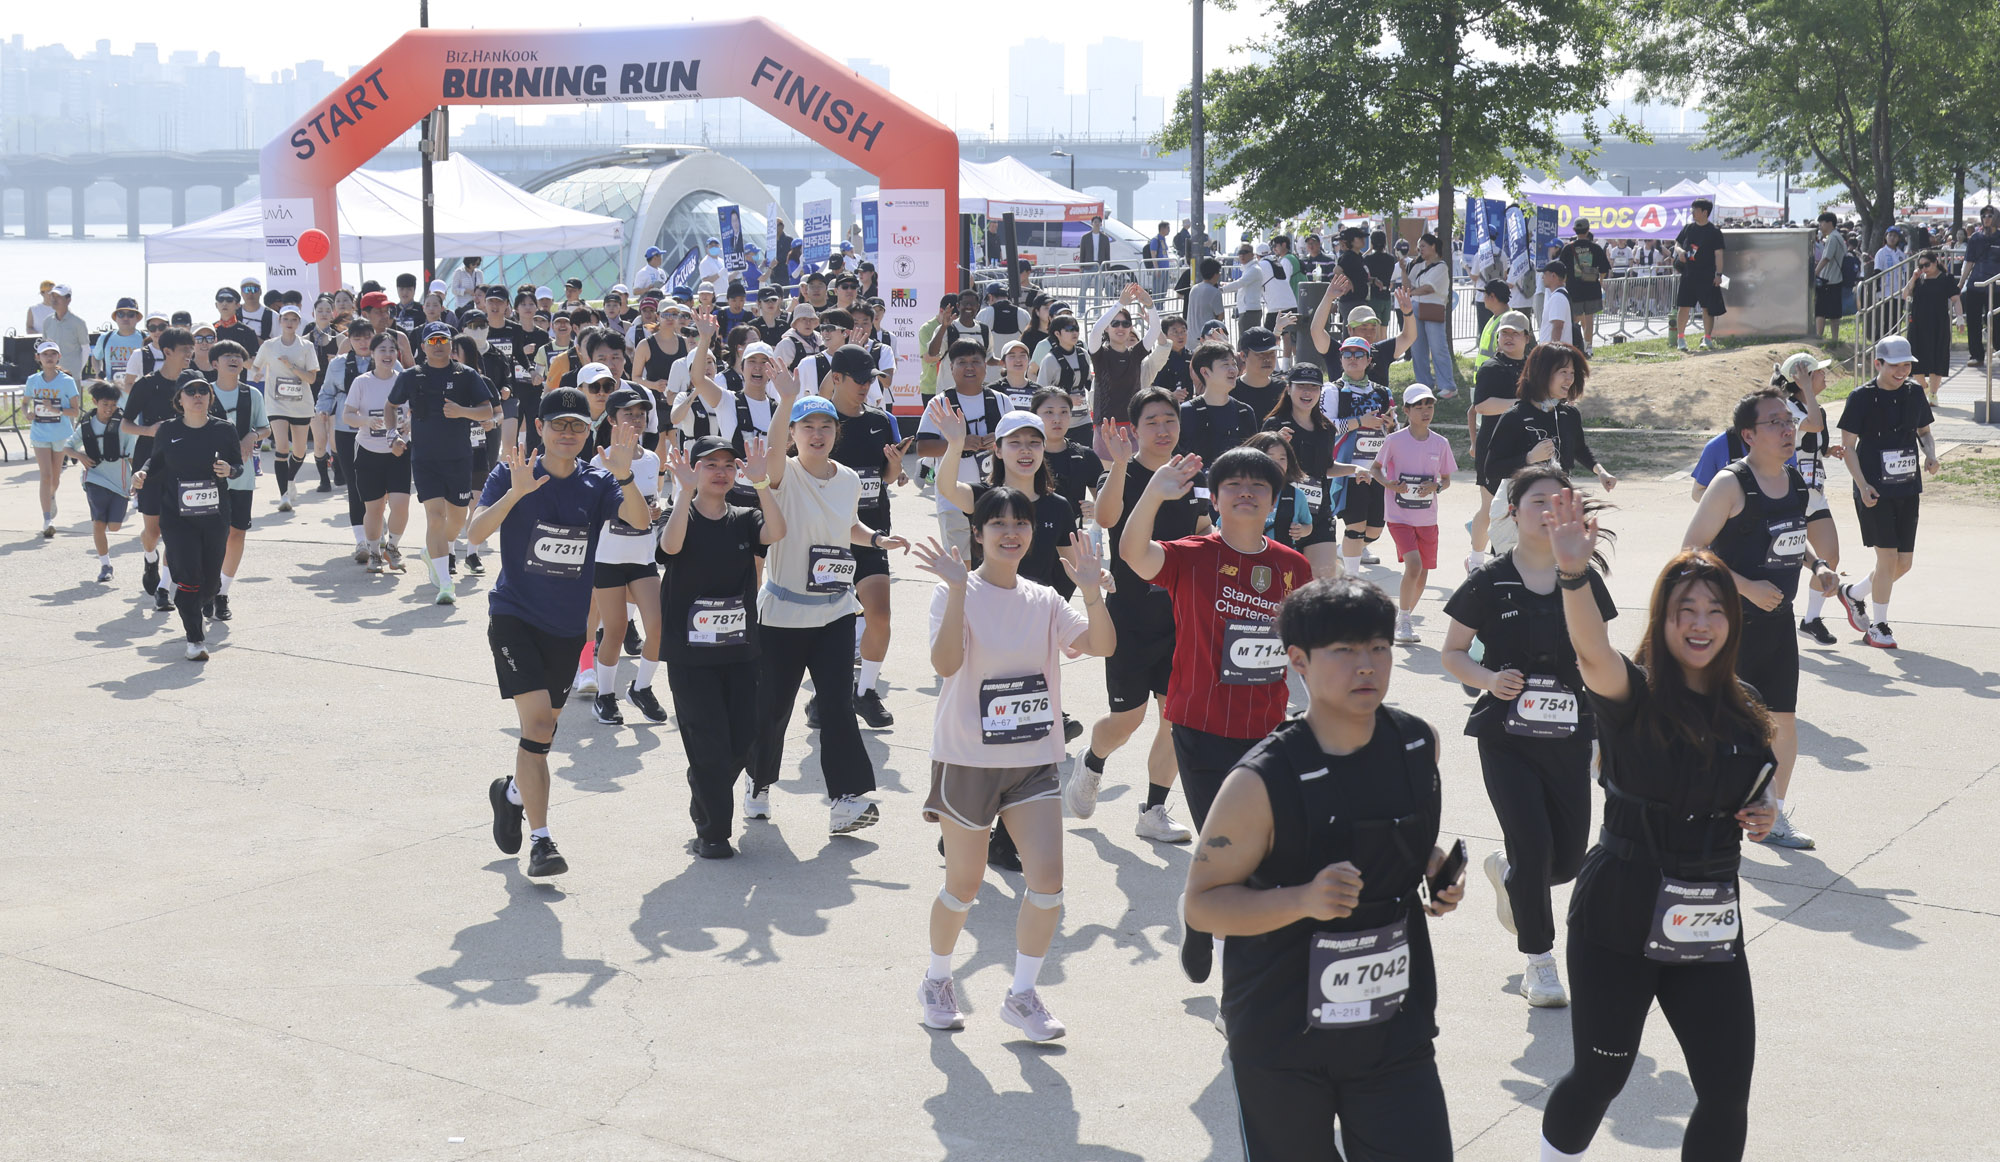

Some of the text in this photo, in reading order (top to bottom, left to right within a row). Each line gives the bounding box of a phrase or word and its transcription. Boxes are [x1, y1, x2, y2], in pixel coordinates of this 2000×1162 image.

[443, 59, 701, 98] BURNING RUN
[612, 94, 658, 102] Running
[659, 91, 702, 100] Festival
[751, 56, 884, 152] FINISH
[290, 68, 391, 160] START
[804, 214, 831, 232] 정근식
[891, 232, 920, 247] Tage
[725, 252, 746, 269] 정근식
[269, 264, 297, 276] Maxim
[891, 299, 917, 308] KIND
[803, 401, 829, 411] HOKA
[470, 429, 484, 437] 968
[1897, 459, 1916, 469] 7219
[860, 480, 880, 490] 079
[195, 491, 217, 500] 7913
[459, 491, 471, 499] NAV
[1789, 534, 1806, 547] 7310
[541, 543, 584, 555] M 7311
[827, 563, 854, 574] 7869
[712, 612, 744, 625] 7874
[1238, 647, 1249, 656] M
[995, 698, 1049, 716] W 7676
[1524, 698, 1574, 712] W 7541
[991, 719, 1011, 727] A-67
[1672, 908, 1735, 927] W 7748
[1333, 955, 1407, 986] M 7042
